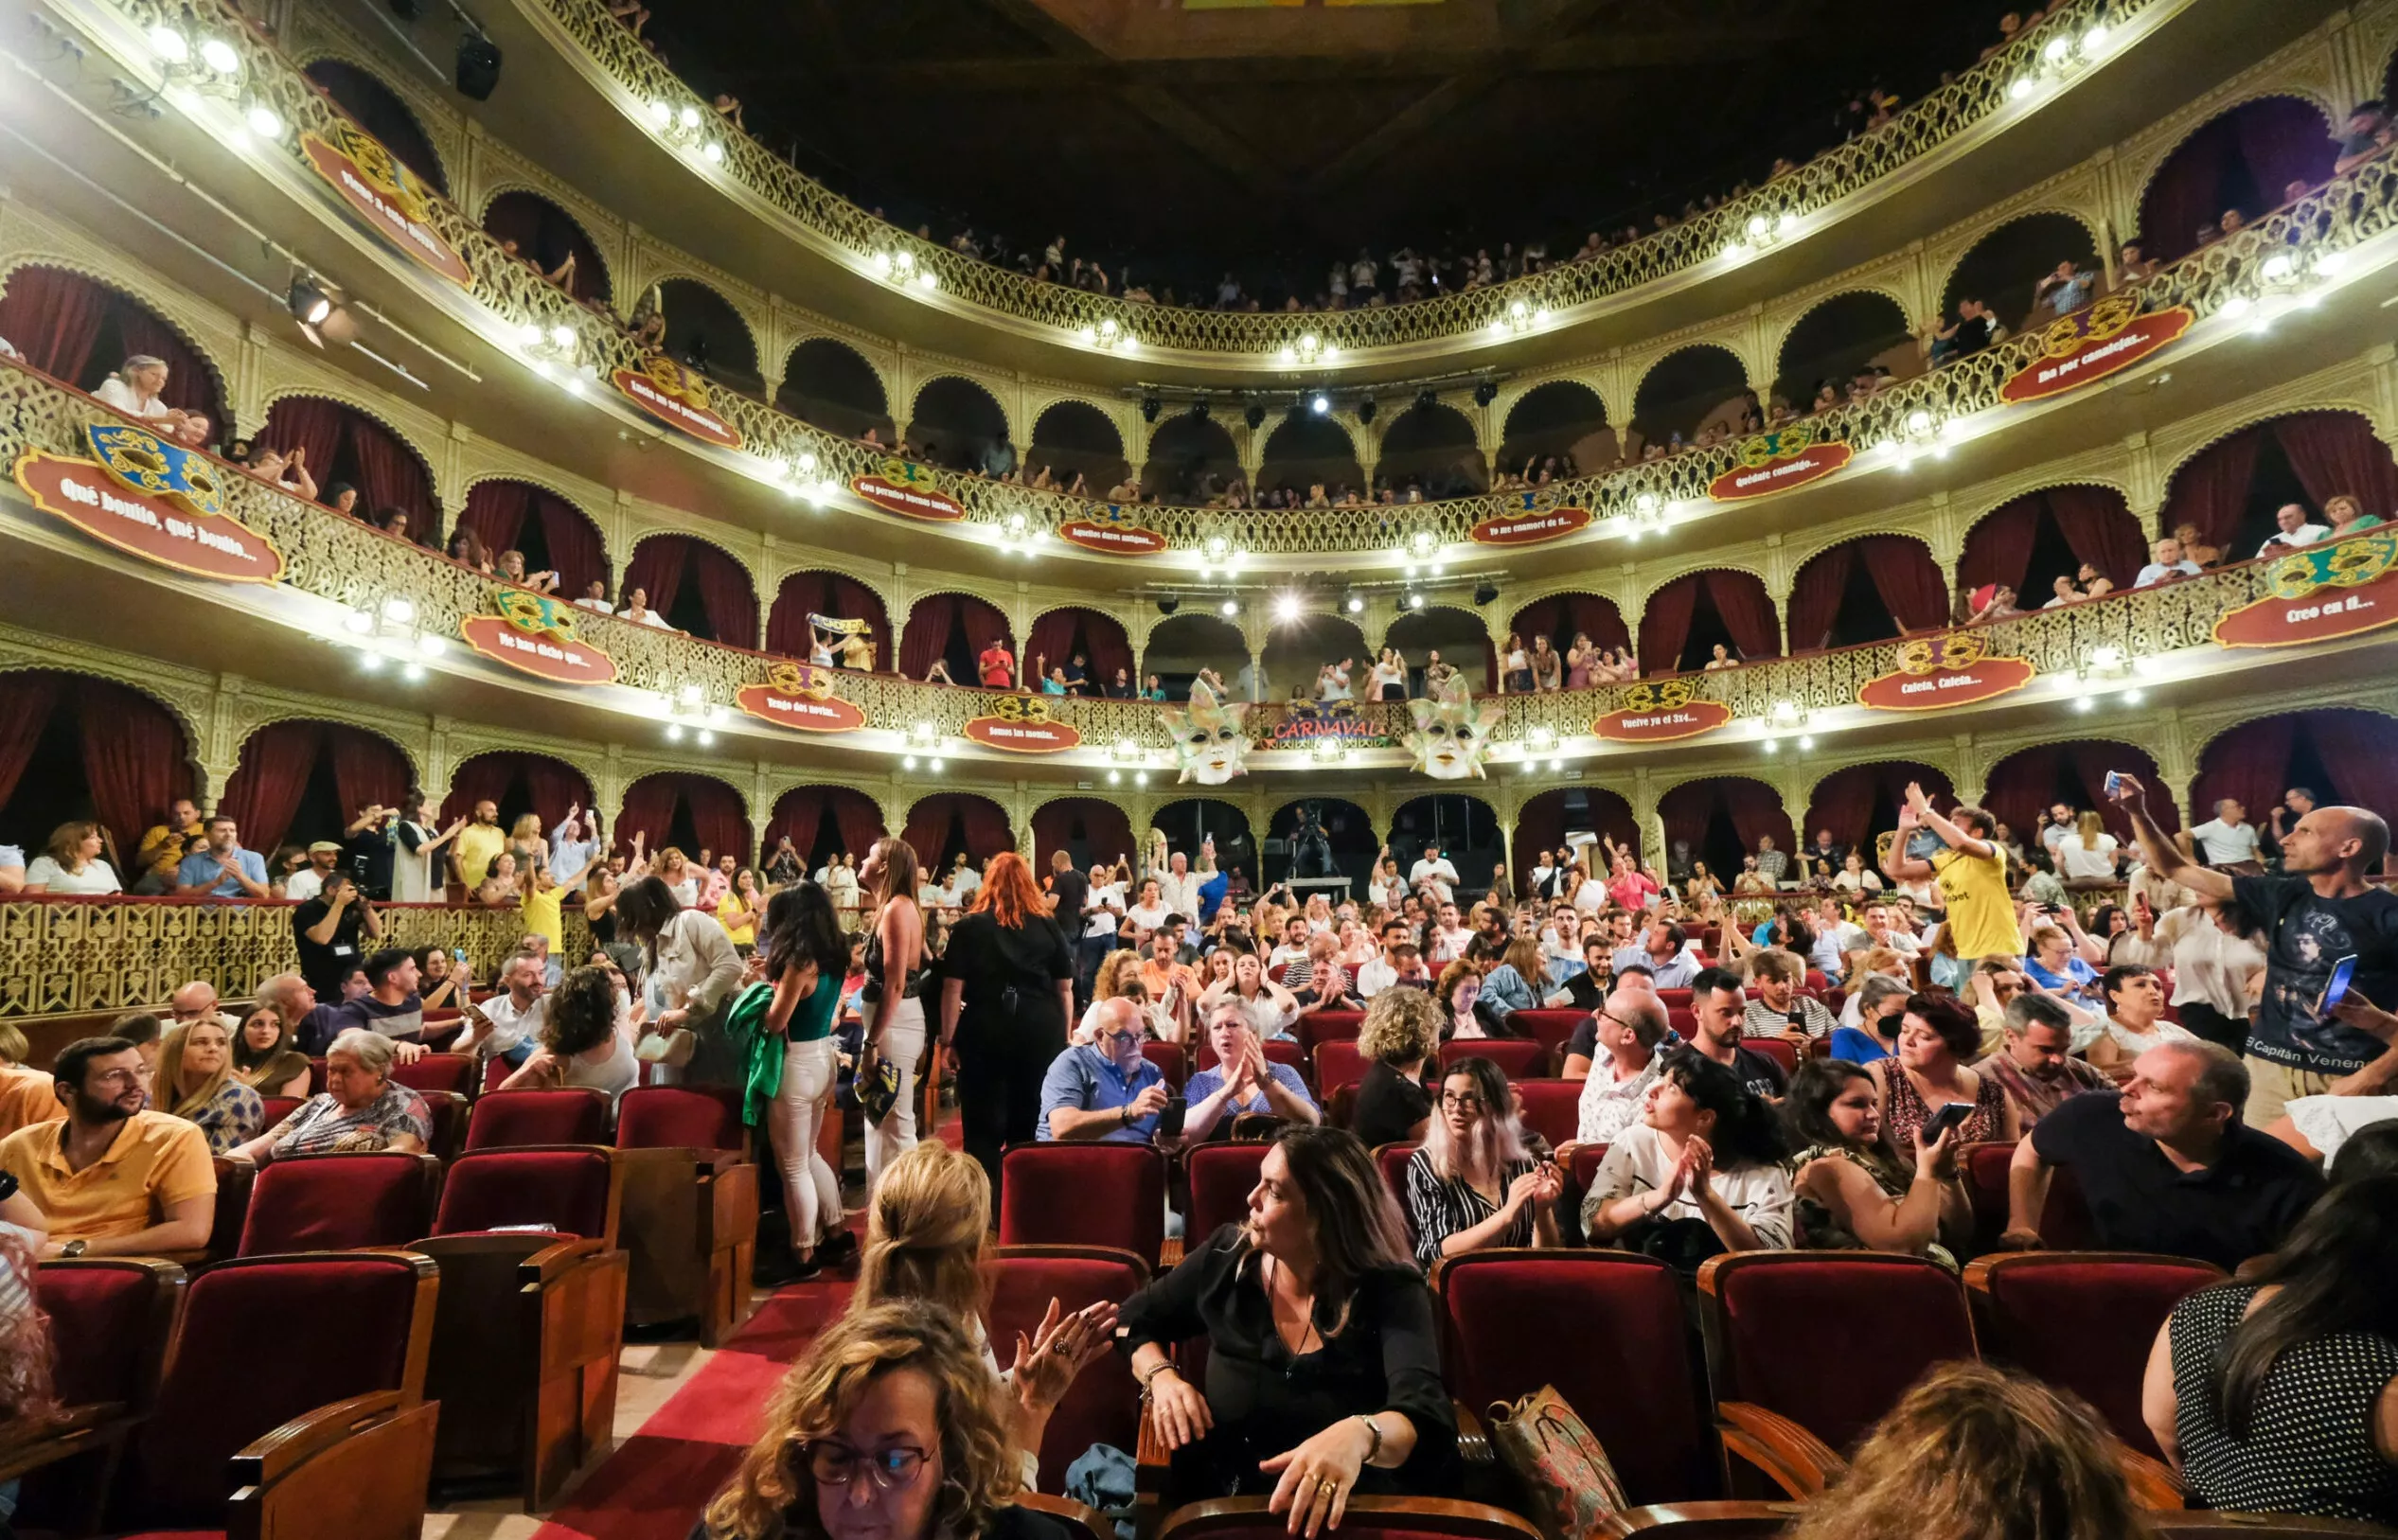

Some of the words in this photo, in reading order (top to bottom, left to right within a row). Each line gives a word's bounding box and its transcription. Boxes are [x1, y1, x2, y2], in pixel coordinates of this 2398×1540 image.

[2059, 359, 2080, 376] por
[1735, 470, 1770, 487] Quédate
[860, 482, 875, 493] Con
[875, 486, 904, 501] permiso
[61, 478, 98, 505] Qué
[101, 491, 163, 531] bonito,
[165, 518, 196, 540] qué
[1489, 527, 1499, 536] Yo
[1500, 526, 1512, 535] me
[1513, 520, 1545, 533] enamoré
[1547, 519, 1556, 527] de
[2286, 606, 2319, 623] Creo
[2322, 601, 2343, 615] en
[2345, 594, 2375, 611] ti...
[498, 631, 515, 648] Me
[515, 636, 537, 653] han
[537, 643, 564, 661] dicho
[1901, 681, 1936, 694] Caleta,
[1938, 675, 1982, 689] Caleta...
[767, 697, 792, 711] Tengo
[793, 701, 808, 713] dos
[988, 726, 1013, 736] Somos
[1013, 728, 1024, 737] las
[1273, 719, 1378, 738] CARNAVAL
[1622, 717, 1649, 729] Vuelve
[1650, 717, 1661, 727] ya
[1662, 715, 1671, 724] el
[2254, 1040, 2300, 1062] Capitán
[2307, 1053, 2368, 1069] Venen
